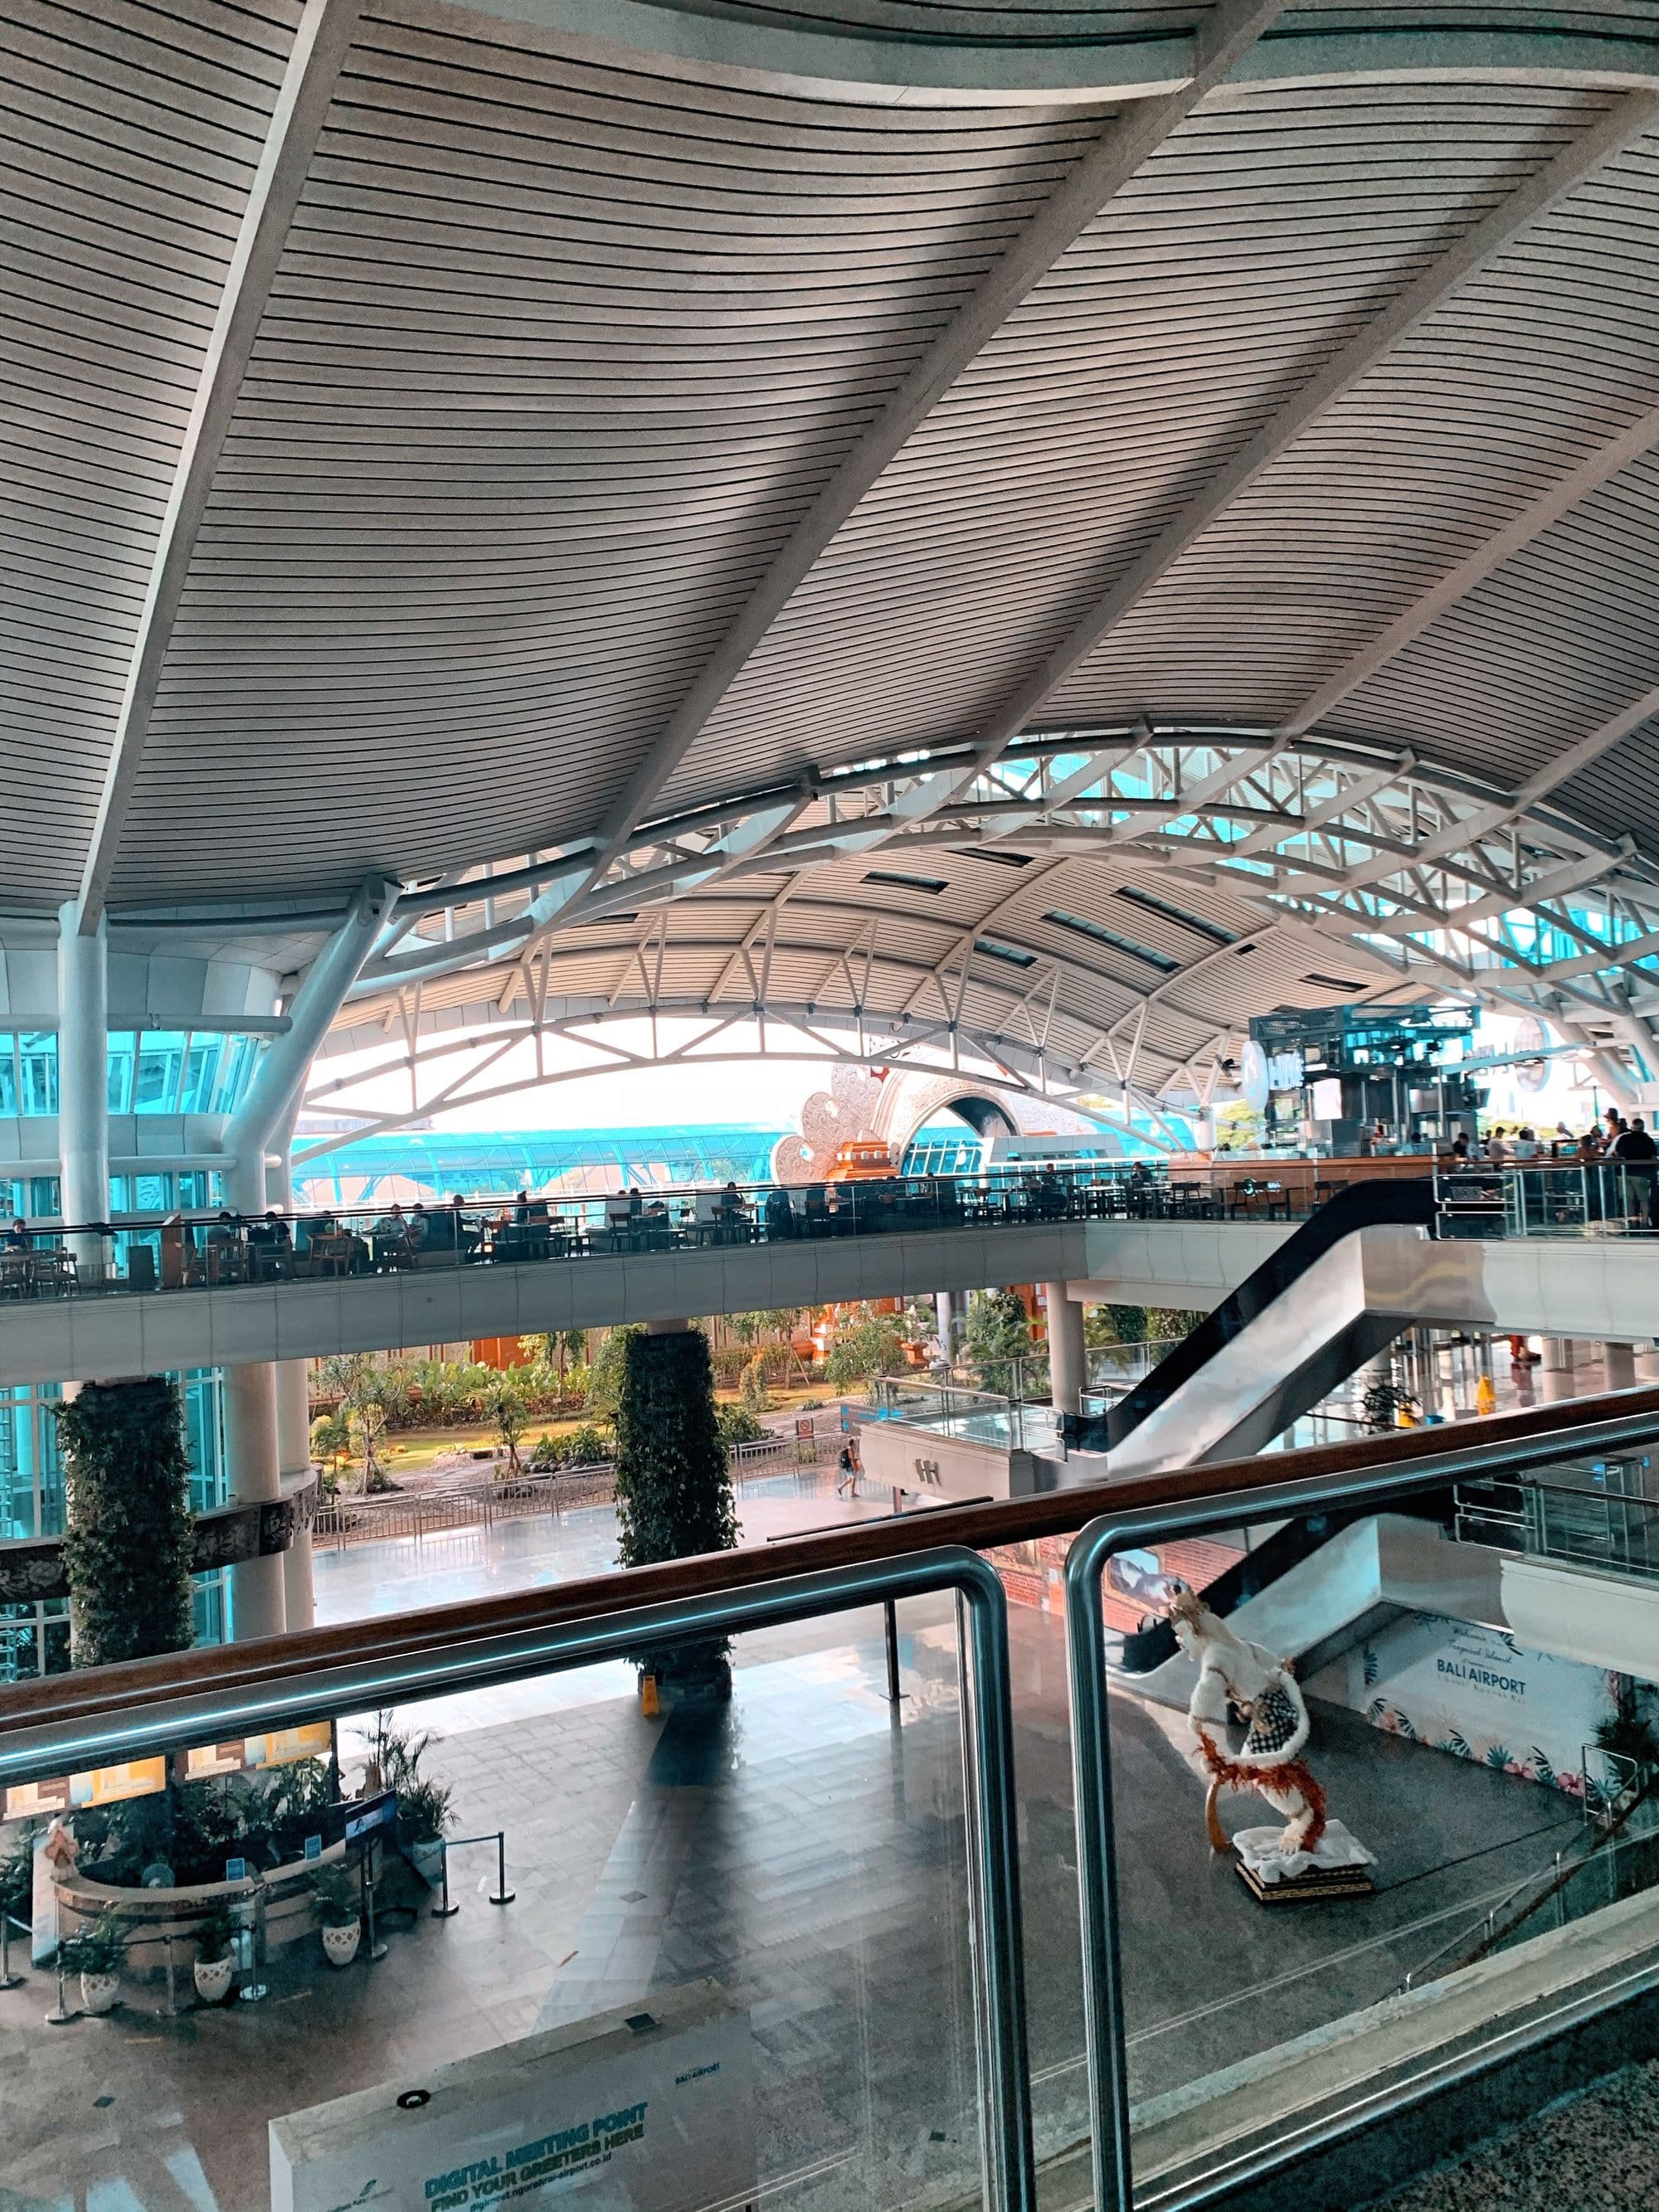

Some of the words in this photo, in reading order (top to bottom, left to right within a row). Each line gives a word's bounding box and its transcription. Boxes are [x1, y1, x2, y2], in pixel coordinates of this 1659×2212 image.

[1437, 1658, 1466, 1679] BALI
[1468, 1668, 1526, 1695] AIRPORT
[425, 2156, 503, 2200] DIGITAL
[506, 2123, 589, 2170] MEETING
[592, 2102, 648, 2138] POINT
[431, 2190, 469, 2212] FIND
[471, 2171, 518, 2199] YOUR
[520, 2140, 601, 2183] GREETERS
[604, 2123, 644, 2151] HERE
